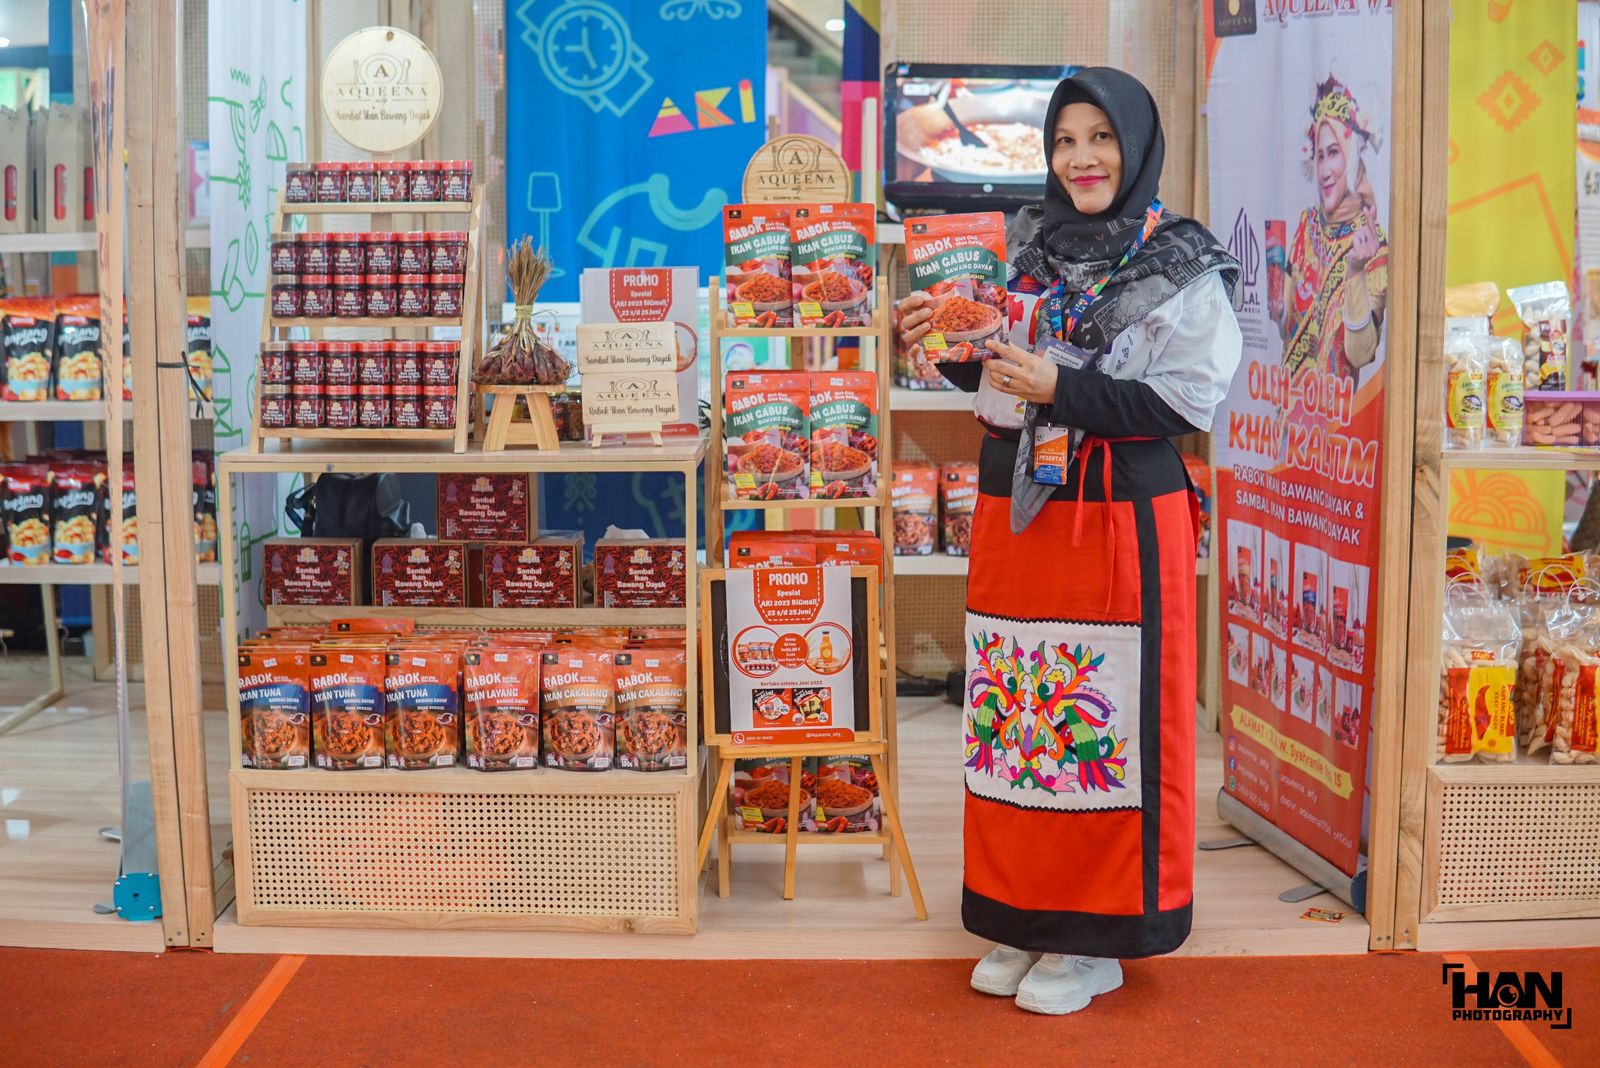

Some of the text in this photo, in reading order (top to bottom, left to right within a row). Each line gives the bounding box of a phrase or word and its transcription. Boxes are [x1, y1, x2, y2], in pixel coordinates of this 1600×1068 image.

[374, 64, 389, 78] A
[336, 86, 428, 99] AQUEENA
[788, 151, 804, 165] A
[757, 174, 836, 186] AQUEENA
[729, 222, 763, 241] RABOK
[796, 221, 830, 240] RABOK
[730, 234, 787, 255] IKAN GABUS
[797, 234, 853, 255] IKAN GABUS
[912, 237, 953, 260] RABOK
[915, 251, 981, 278] IKAN GABUS
[944, 263, 994, 275] BAWANG DAYAK
[623, 274, 659, 287] PROMO
[592, 342, 663, 350] AQUEENA
[1248, 360, 1354, 427] OLEH-OLEH
[732, 393, 765, 411] RABOK
[733, 405, 788, 426] IKAN GABUS
[822, 404, 856, 417] GABUS
[1229, 411, 1283, 462] KHAS
[1234, 464, 1265, 487] RABOK
[1281, 483, 1324, 506] BAWANG
[1355, 501, 1364, 520] &
[470, 496, 496, 504] Sambal
[458, 509, 486, 518] Bawang
[1236, 489, 1270, 514] SAMBAL
[1288, 509, 1327, 535] BAWANG
[406, 567, 432, 575] Sambal
[516, 567, 542, 575] Sambal
[284, 579, 311, 588] Bawang
[395, 580, 422, 588] Bawang
[505, 580, 533, 588] Bawang
[616, 580, 645, 589] Bawang
[769, 572, 808, 586] PROMO
[776, 589, 801, 597] Spesial
[239, 672, 273, 688] RABOK
[313, 673, 348, 689] RABOK
[384, 673, 421, 689] RABOK
[466, 672, 501, 688] RABOK
[544, 672, 578, 688] RABOK
[617, 672, 653, 689] RABOK
[239, 688, 281, 702] IKAN TUNA
[314, 688, 356, 704] IKAN TUNA
[386, 688, 428, 703] IKAN TUNA
[467, 688, 518, 702] IKAN LAYANG
[544, 688, 608, 702] IKAN CAKALANG
[617, 688, 682, 703] IKAN CAKALANG
